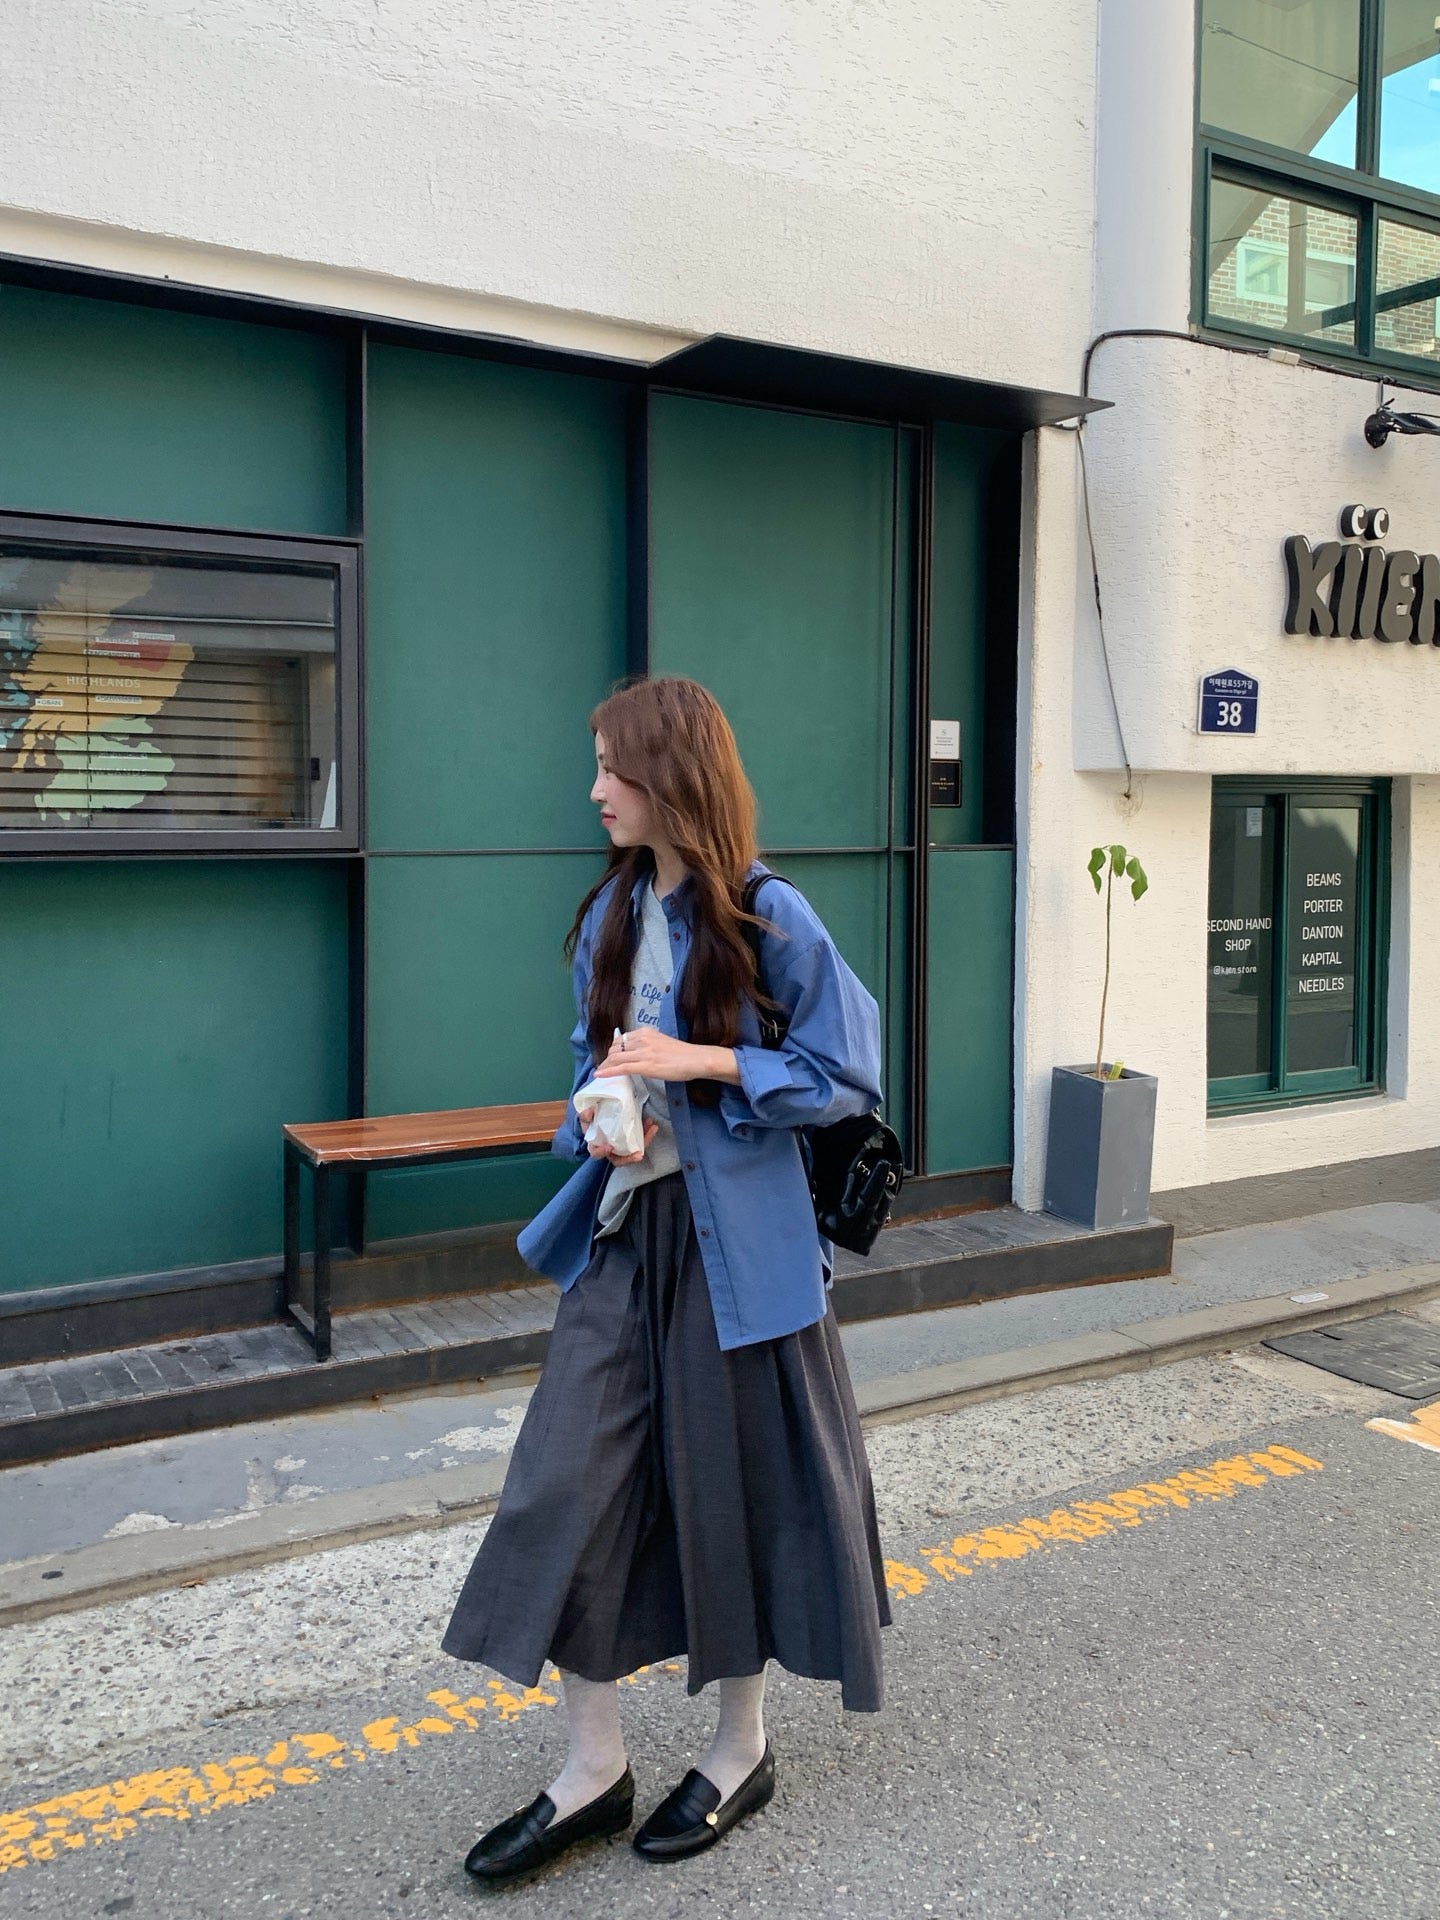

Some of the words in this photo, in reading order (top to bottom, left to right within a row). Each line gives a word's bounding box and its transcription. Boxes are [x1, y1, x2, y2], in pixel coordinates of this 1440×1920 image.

[66, 676, 141, 688] HIGHLANDS
[1208, 678, 1253, 690] 이태원로55가길
[1216, 701, 1242, 727] 38
[1306, 873, 1342, 887] BEAMS
[1304, 899, 1343, 913] PORTER
[1206, 919, 1244, 932] SECOND
[1245, 918, 1272, 930] HAND
[1302, 925, 1343, 940] DANTON
[1225, 939, 1251, 952] SHOP
[1302, 951, 1343, 967] KAPITAL
[1299, 977, 1345, 993] NEEDLES
[641, 983, 662, 1005] life
